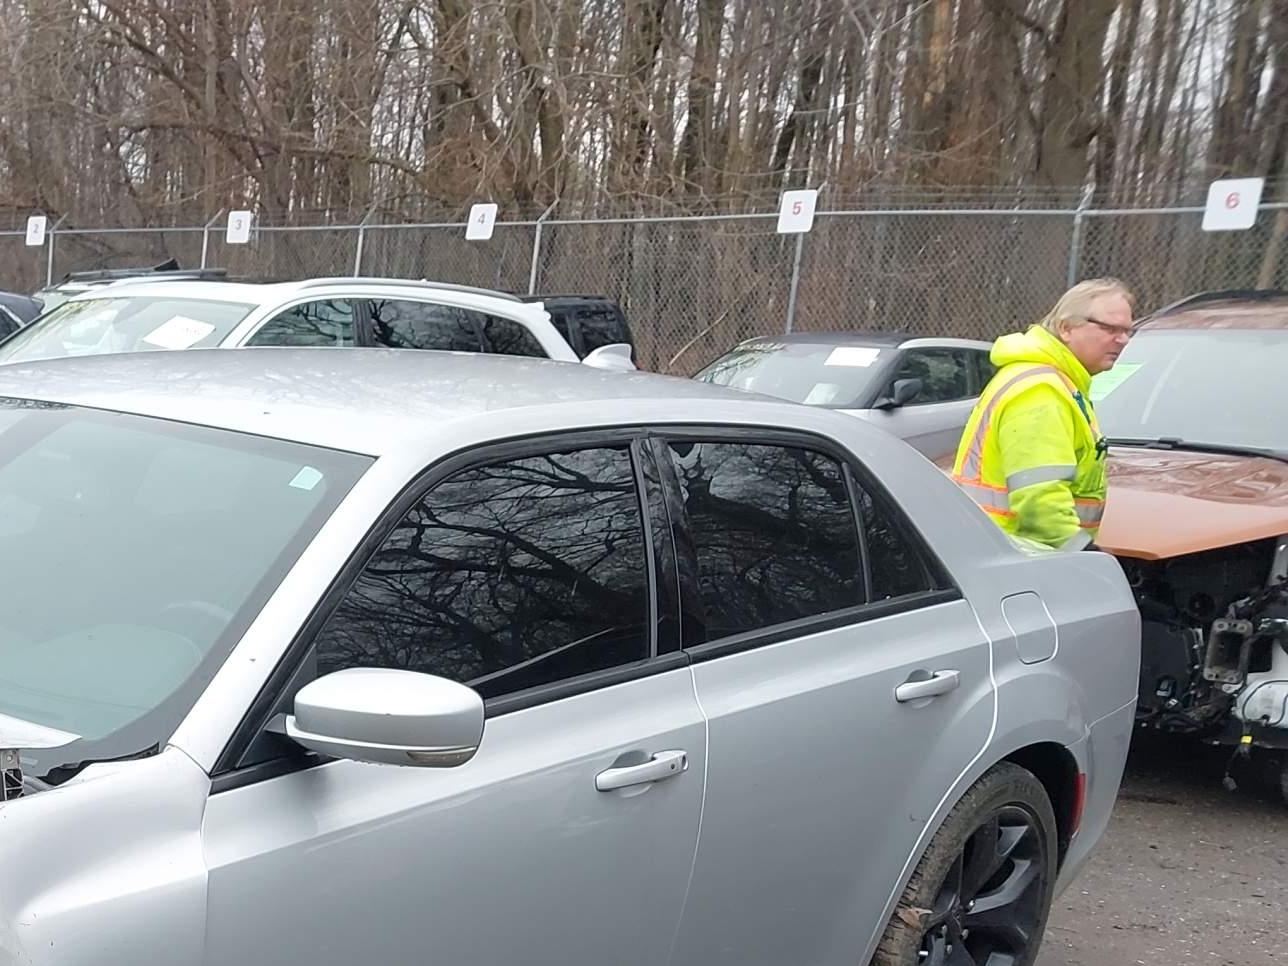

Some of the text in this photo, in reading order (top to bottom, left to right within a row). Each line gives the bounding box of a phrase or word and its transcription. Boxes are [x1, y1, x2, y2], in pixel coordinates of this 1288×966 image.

[1225, 192, 1240, 209] 6
[792, 201, 802, 216] 5
[235, 219, 242, 230] 3
[478, 213, 486, 225] 4
[33, 223, 40, 234] 2
